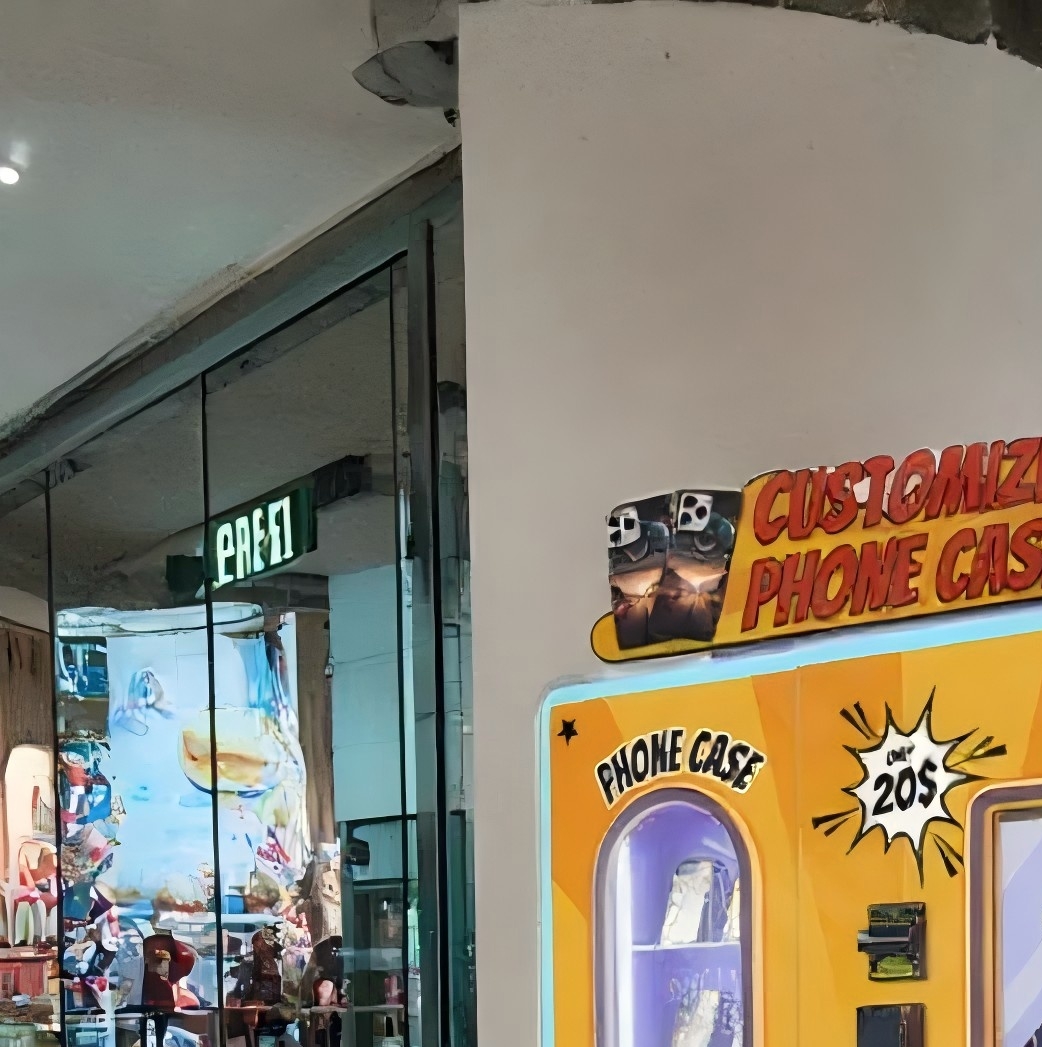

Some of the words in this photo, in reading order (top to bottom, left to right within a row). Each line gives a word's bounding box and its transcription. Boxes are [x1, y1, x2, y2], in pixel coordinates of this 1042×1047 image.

[741, 533, 929, 633] PHONE
[597, 729, 684, 805] PHONE
[688, 730, 764, 791] CASE
